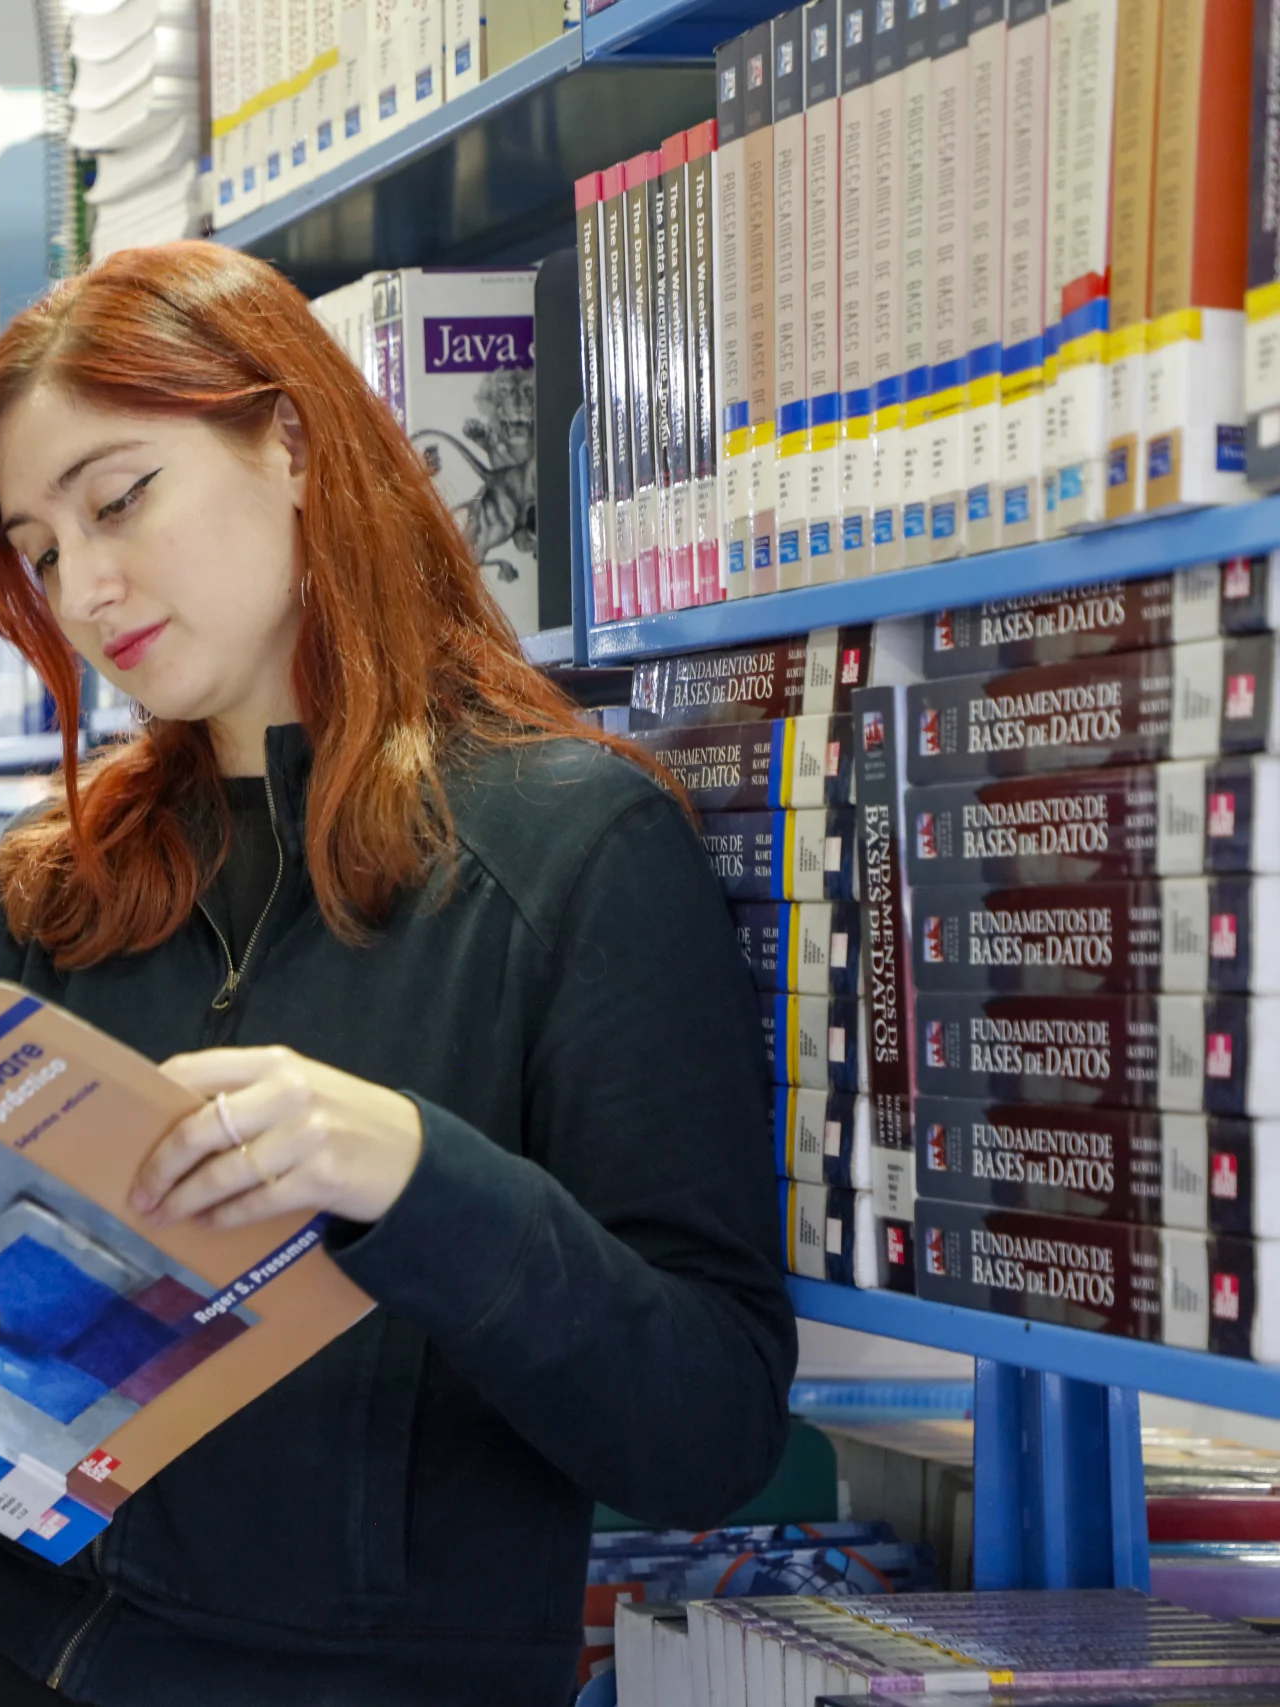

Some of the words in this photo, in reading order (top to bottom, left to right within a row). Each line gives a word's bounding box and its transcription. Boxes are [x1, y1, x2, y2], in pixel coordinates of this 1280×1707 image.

[696, 171, 705, 208] The
[844, 121, 860, 262] PROCESAMIENTO
[876, 108, 891, 251] PROCESAMIENTO
[633, 199, 642, 235] The
[655, 192, 664, 226] The
[670, 181, 679, 219] The
[778, 149, 793, 284] PROCESAMIENTO
[811, 134, 826, 272] PROCESAMIENTO
[583, 220, 591, 254] The
[609, 211, 618, 246] The
[671, 222, 680, 268] Data
[697, 212, 706, 258] Data
[723, 172, 737, 302] PROCESAMIENTO
[749, 160, 763, 293] PROCESAMIENTO
[634, 239, 643, 282] Data
[656, 229, 665, 274] Data
[585, 260, 593, 300] Data
[611, 250, 619, 293] Data
[844, 270, 860, 292] DE
[876, 260, 891, 282] DE
[779, 293, 793, 313] DE
[811, 280, 826, 301] DE
[725, 311, 737, 330] DE
[751, 303, 764, 321] DE
[844, 300, 860, 352] BASES
[875, 290, 891, 344] BASES
[433, 325, 517, 367] Java
[779, 322, 794, 373] BASES
[811, 310, 826, 362] BASES
[725, 340, 738, 388] BASES
[751, 331, 765, 382] BASES
[844, 360, 860, 380] DE
[875, 351, 890, 372] DE
[752, 389, 765, 407] DE
[780, 380, 794, 399] DE
[811, 370, 826, 390] DE
[980, 617, 1034, 647] BASES
[1036, 614, 1057, 637] DE
[1058, 596, 1125, 632] DATOS
[676, 657, 757, 682] FUNDAMENTOS
[760, 652, 775, 672] DE
[673, 680, 710, 707] BASES
[712, 685, 727, 704] DE
[727, 674, 774, 702] DATOS
[969, 685, 1095, 723] FUNDAMENTOS
[1096, 682, 1122, 708] DE
[968, 720, 1024, 753] BASES
[1026, 724, 1049, 747] DE
[1050, 710, 1122, 743] DATOS
[655, 746, 726, 767] FUNDAMENTOS
[727, 744, 742, 763] DE
[687, 772, 700, 789] DE
[700, 765, 741, 787] DATOS
[962, 795, 1083, 828] FUNDAMENTOS
[1084, 793, 1109, 819] DE
[729, 835, 744, 853] DE
[865, 805, 881, 902] BASES
[963, 829, 1017, 859] BASES
[1020, 833, 1040, 855] DE
[1040, 822, 1109, 855] DATOS
[709, 854, 744, 877] ATOS
[870, 911, 880, 944] DE
[878, 805, 897, 1020] FUNDAMENTOS
[969, 909, 1087, 935] FUNDAMENTOS
[1088, 908, 1112, 932] DE
[969, 936, 1022, 966] BASES
[1024, 943, 1045, 965] DE
[1045, 935, 1112, 965] DATOS
[871, 951, 889, 1063] DATOS
[887, 1026, 899, 1063] DE
[970, 1018, 1086, 1046] FUNDAMENTOS
[1087, 1021, 1111, 1046] DE
[970, 1044, 1022, 1075] BASES
[1024, 1052, 1045, 1076] DE
[1046, 1047, 1111, 1079] DATOS
[972, 1123, 1089, 1155] FUNDAMENTOS
[1090, 1133, 1113, 1159] DE
[972, 1150, 1024, 1183] BASES
[1026, 1161, 1048, 1184] DE
[1048, 1156, 1114, 1193] DATOS
[971, 1229, 1089, 1267] FUNDAMENTOS
[1090, 1247, 1114, 1273] DE
[193, 1291, 237, 1324] Roger
[234, 1281, 255, 1295] S.
[249, 1229, 319, 1284] Pressman
[971, 1256, 1024, 1292] BASES
[1026, 1272, 1048, 1295] DE
[1048, 1268, 1114, 1308] DATOS
